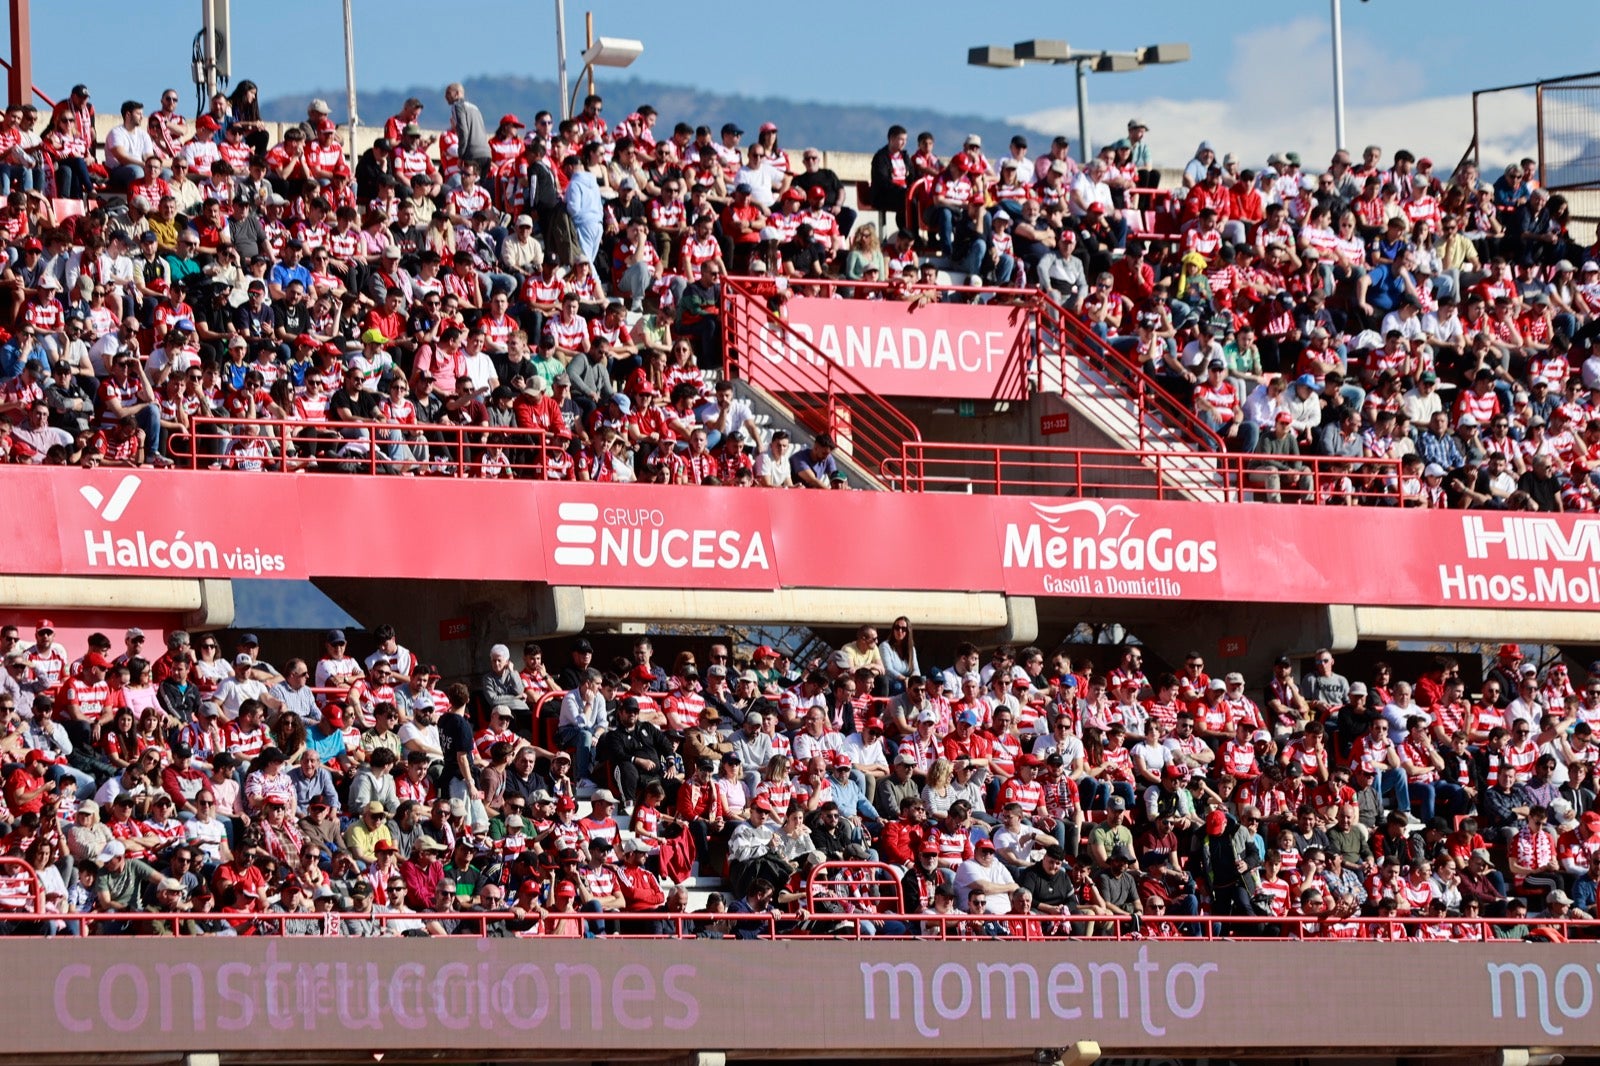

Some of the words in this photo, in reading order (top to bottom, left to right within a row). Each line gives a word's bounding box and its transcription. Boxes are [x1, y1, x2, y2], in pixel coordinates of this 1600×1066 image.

[603, 507, 665, 527] GRUPO
[83, 529, 219, 569] Halcón
[222, 547, 286, 575] viajes
[600, 527, 770, 570] NUCESA
[1002, 523, 1218, 573] MensaGas
[1043, 574, 1091, 594] Gasoil
[1094, 580, 1104, 594] a
[1106, 575, 1181, 597] Domicilio
[1438, 564, 1600, 604] Hnos.Mol
[53, 938, 701, 1032] construcciones
[860, 945, 1219, 1038] momento
[1487, 962, 1600, 1036] mo
